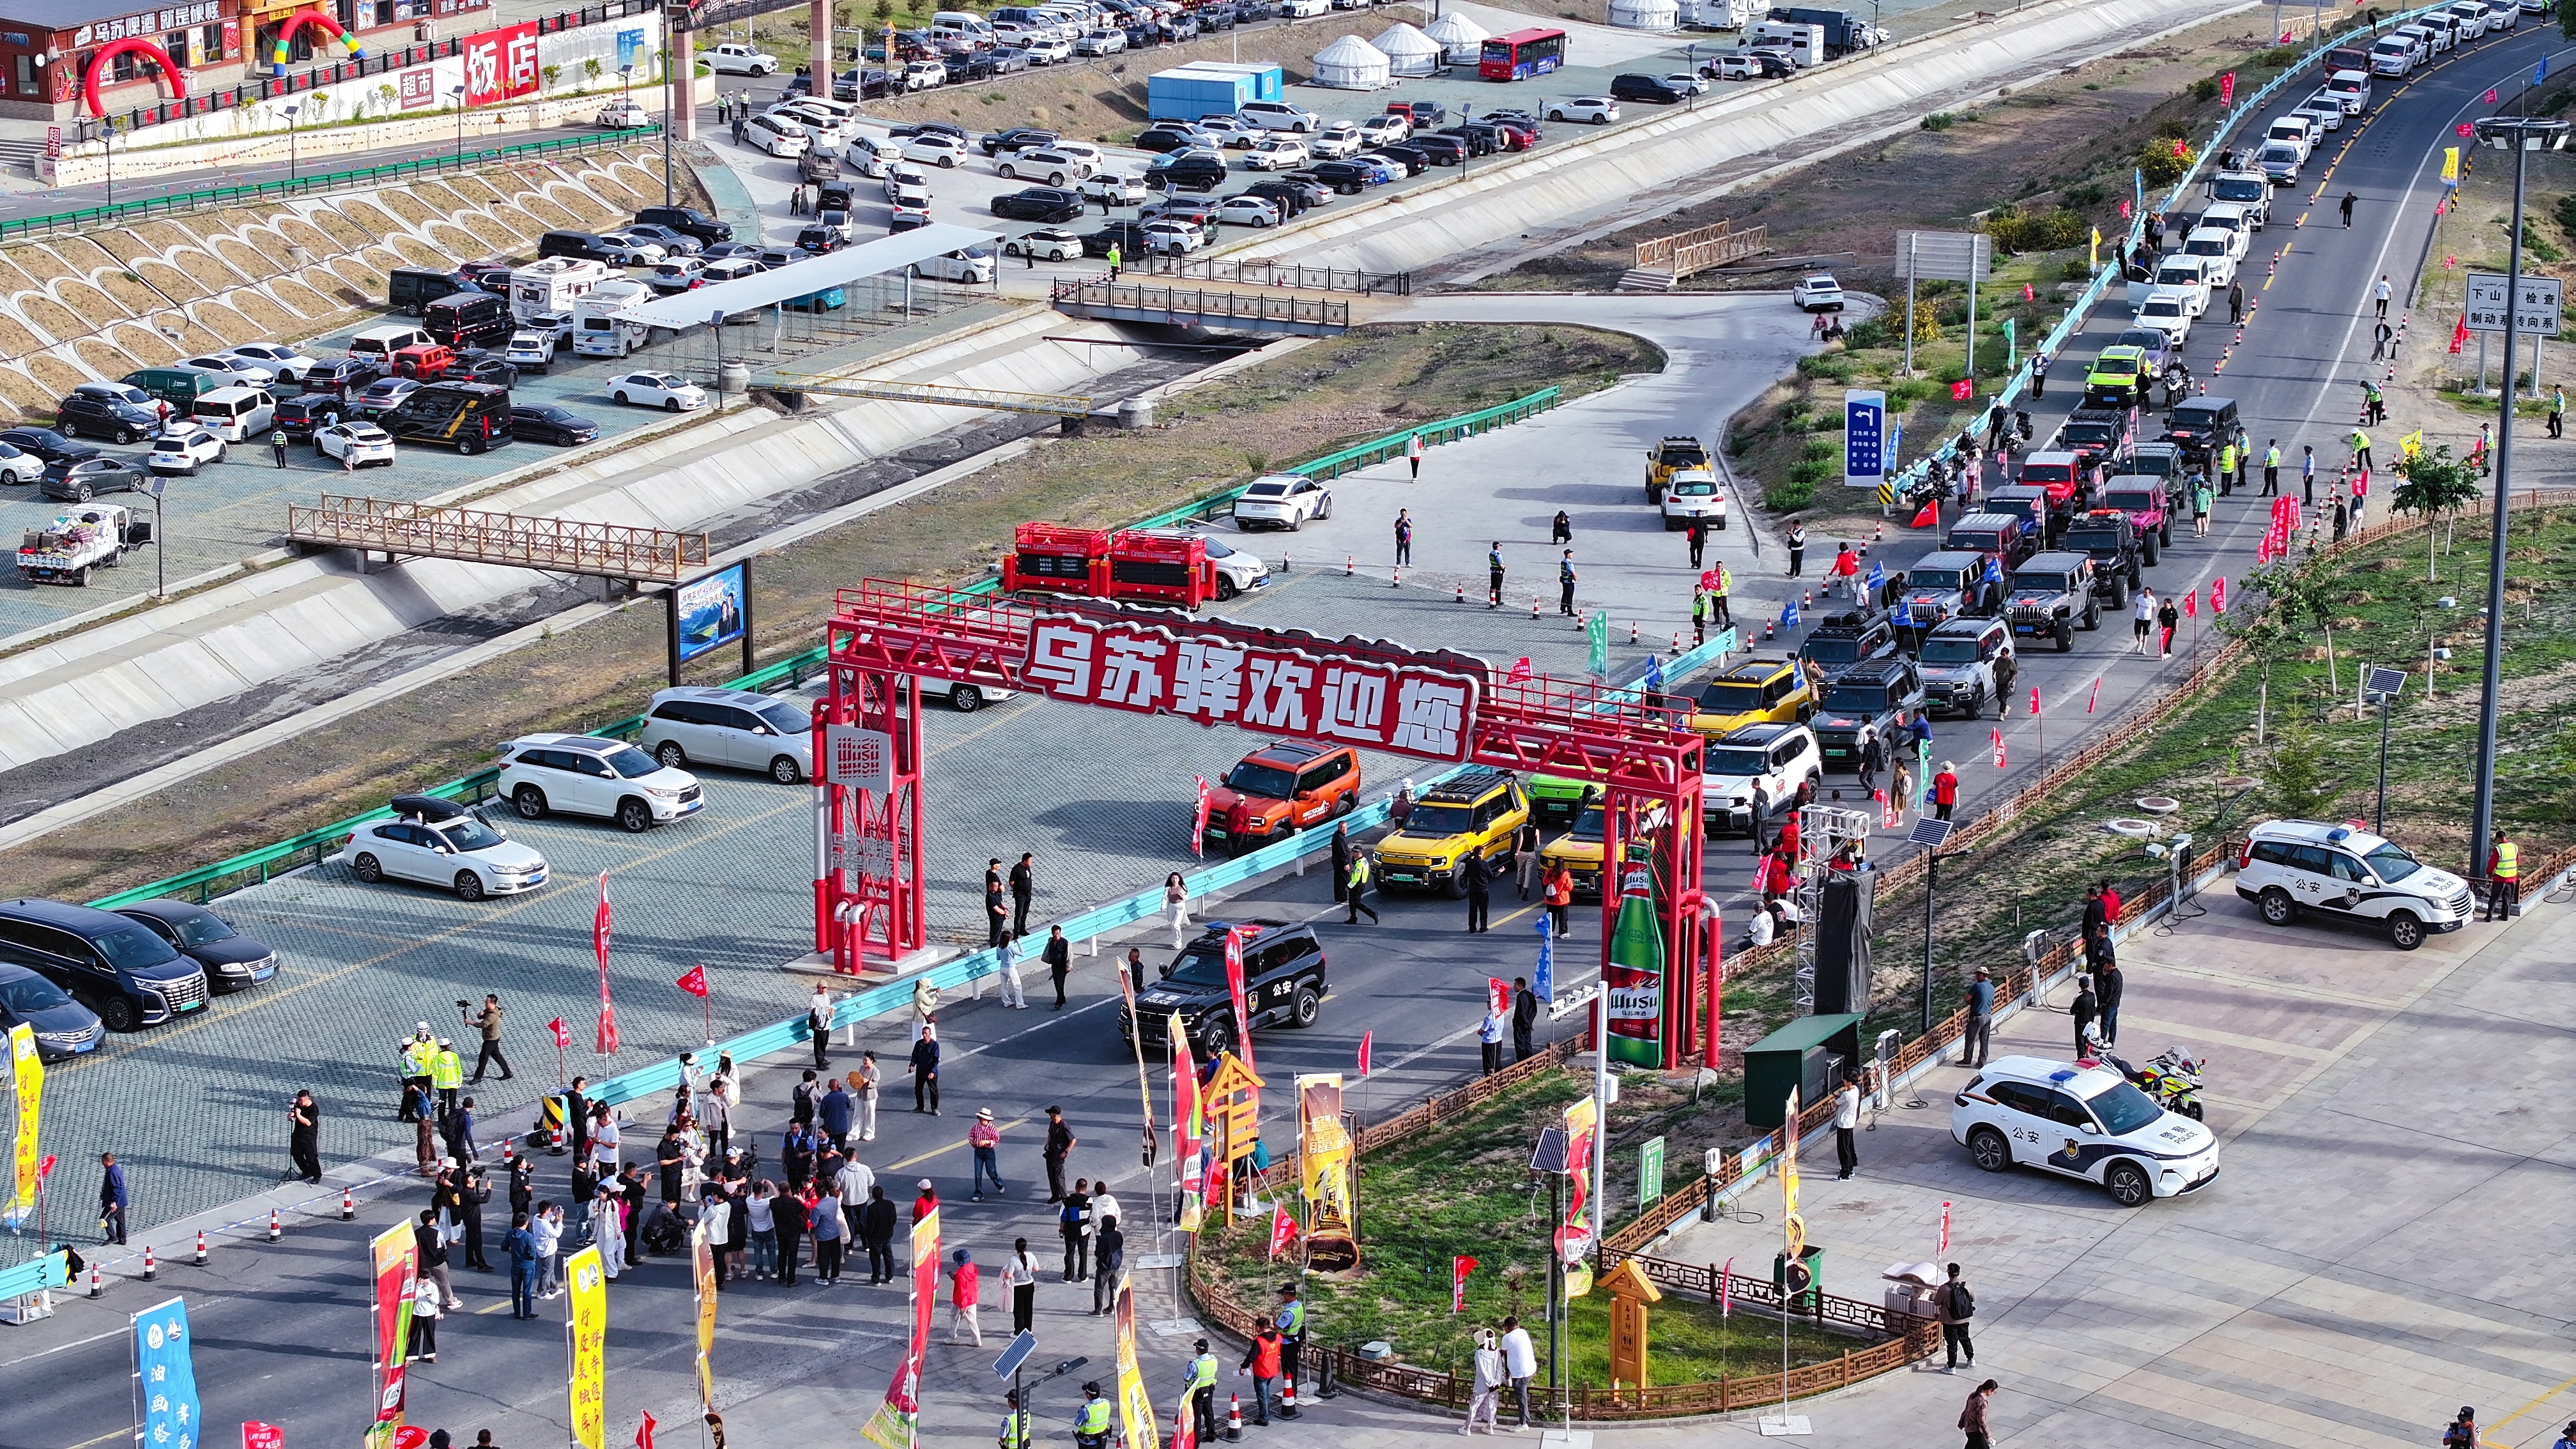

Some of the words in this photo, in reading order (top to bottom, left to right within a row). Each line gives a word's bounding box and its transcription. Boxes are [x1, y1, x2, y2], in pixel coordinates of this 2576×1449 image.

[95, 12, 156, 42] 乌苏啤酒
[160, 1, 220, 30] 就是硬核
[467, 32, 536, 96] 饭店
[402, 72, 431, 96] 超市
[49, 128, 59, 155] 超市
[2472, 288, 2555, 305] 下山检查
[1028, 625, 1467, 757] 乌苏驿欢迎您
[2296, 878, 2320, 894] 公安
[1273, 980, 1292, 996] 公安
[2012, 1126, 2039, 1144] 公安
[2159, 1126, 2188, 1140] 警察
[2174, 1131, 2198, 1144] POLICE
[150, 1364, 172, 1443] 油画塔
